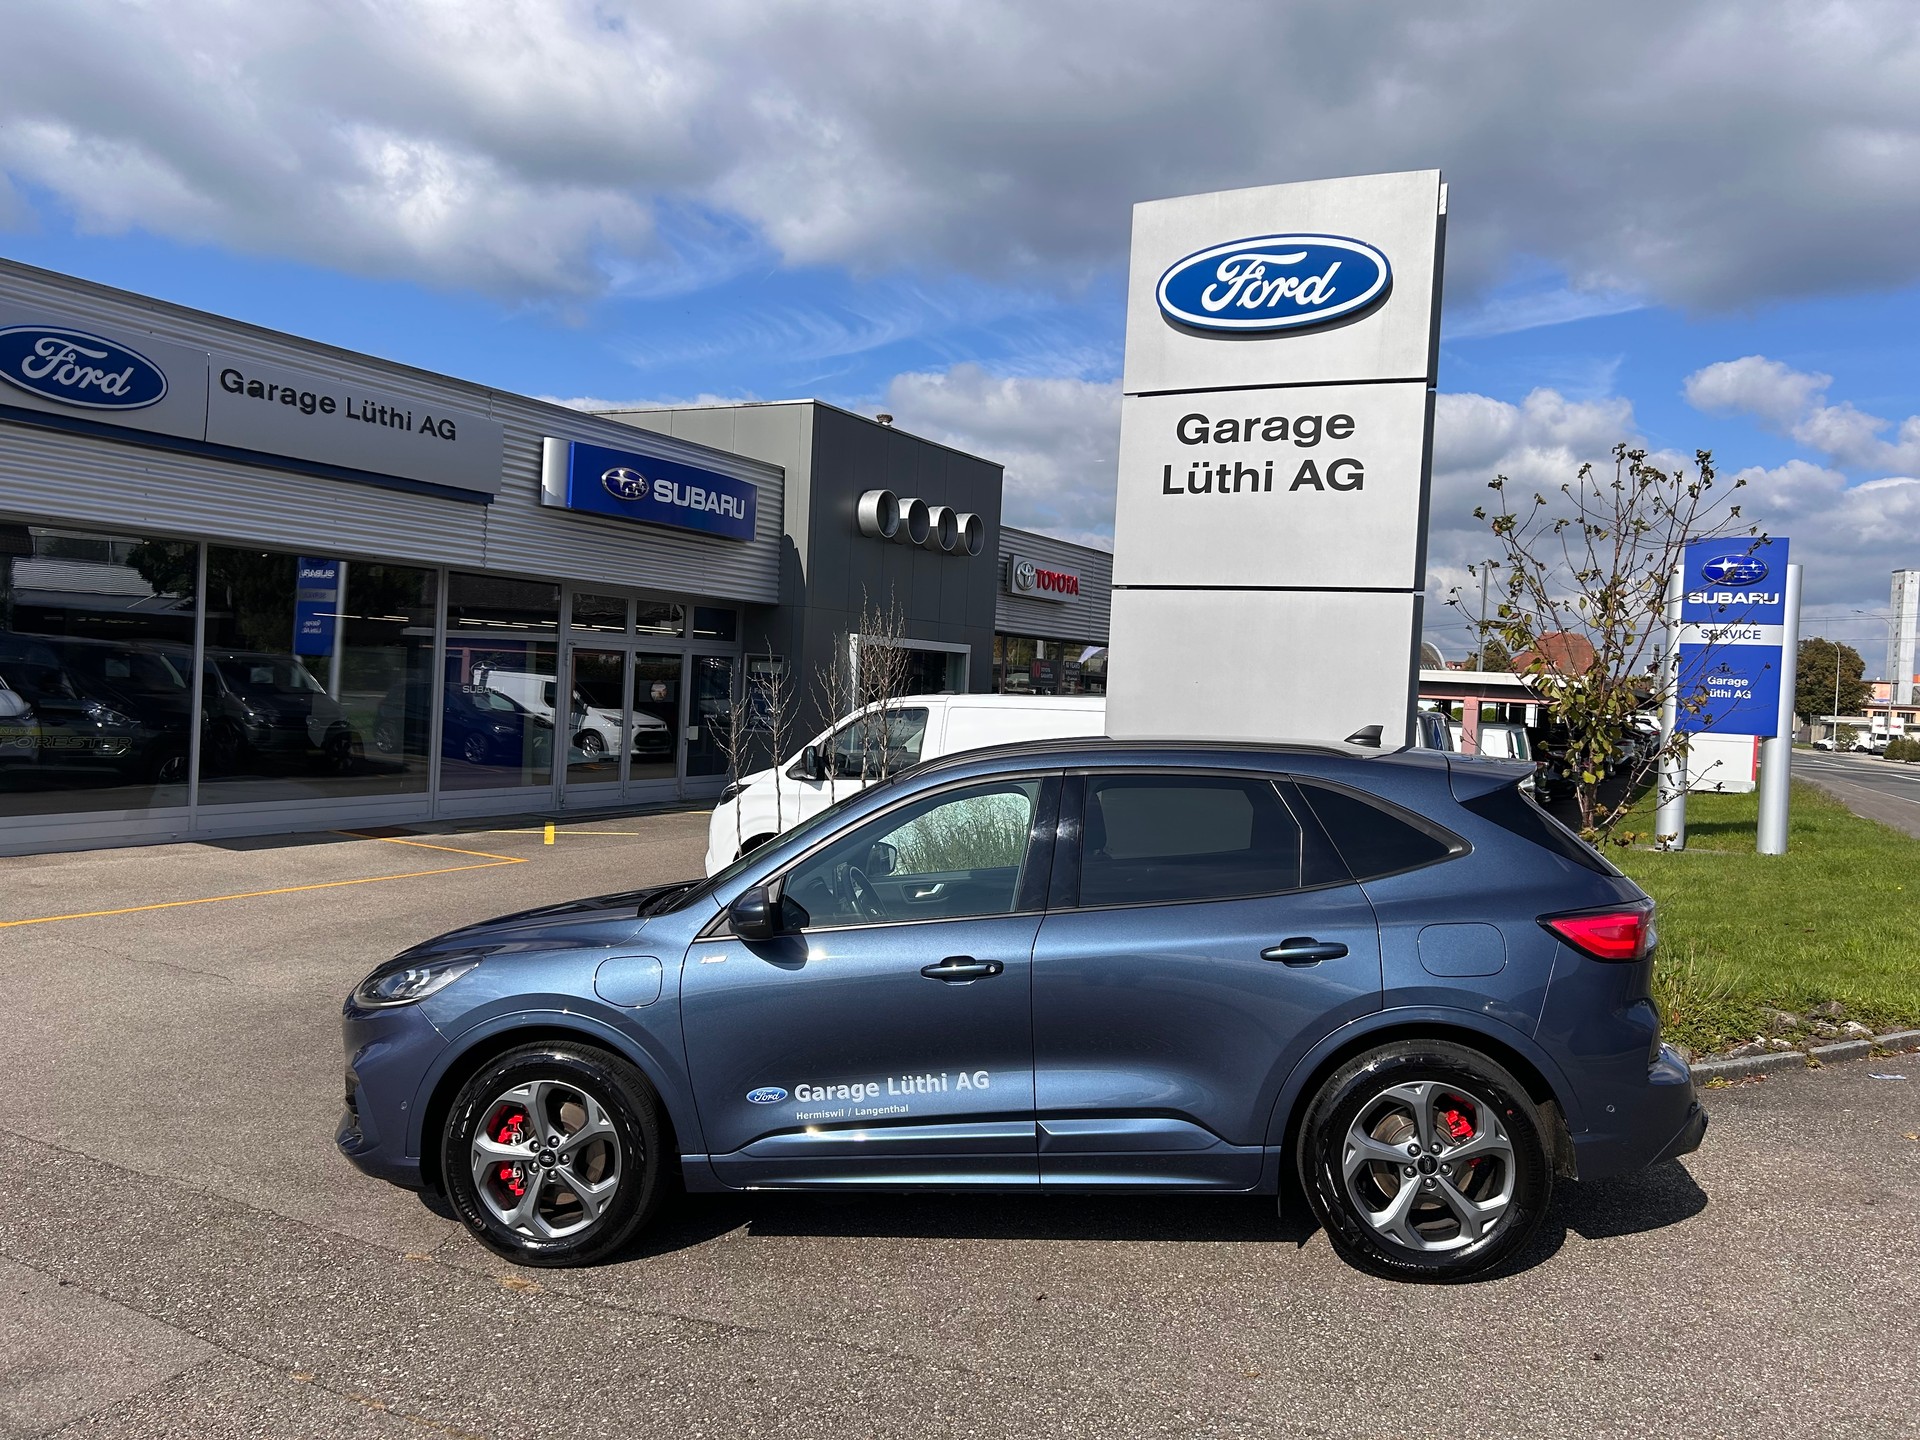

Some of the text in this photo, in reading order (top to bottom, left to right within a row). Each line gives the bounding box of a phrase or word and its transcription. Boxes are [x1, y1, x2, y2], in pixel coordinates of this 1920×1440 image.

[1201, 251, 1342, 312] Ford
[21, 336, 134, 397] Ford
[219, 368, 457, 442] Garage Lüthi AG
[1176, 412, 1356, 448] Garage
[1162, 458, 1365, 495] Lüthi AG
[653, 479, 745, 520] SUBARU
[1035, 568, 1079, 595] TOYOTA
[1688, 592, 1780, 605] SUBARU
[1706, 689, 1752, 699] üthi AG
[1707, 676, 1748, 687] Garage
[0, 735, 133, 749] FORESTER
[754, 1088, 780, 1102] Ford
[794, 1070, 990, 1102] Garage Lüthi AG
[796, 1107, 844, 1120] Hermiswil
[855, 1104, 909, 1116] Langenthal
